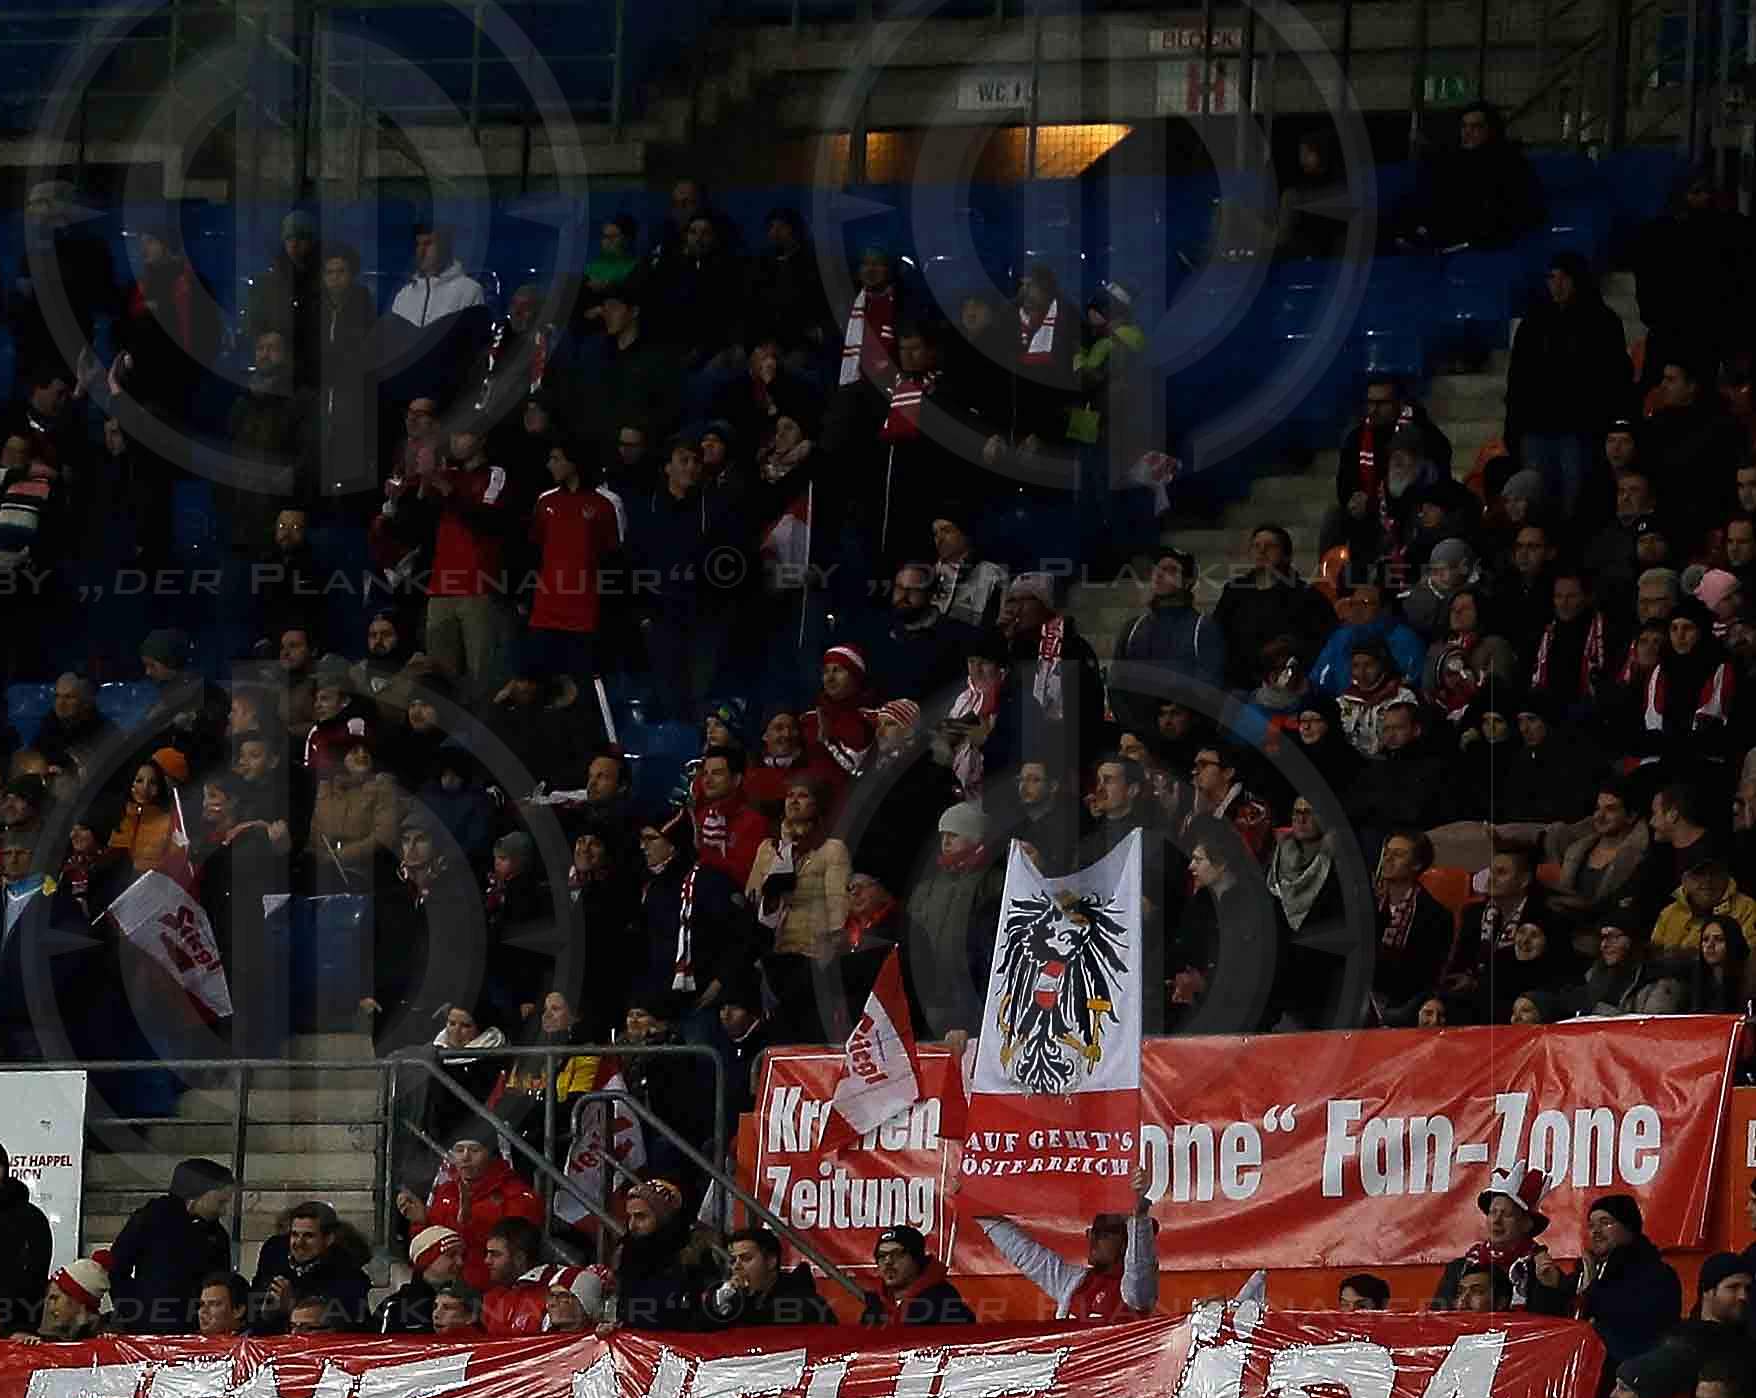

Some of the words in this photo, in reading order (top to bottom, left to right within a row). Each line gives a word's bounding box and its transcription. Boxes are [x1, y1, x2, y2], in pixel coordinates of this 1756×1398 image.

[767, 1087, 941, 1153] Kren
[965, 1131, 1020, 1152] AUF
[30, 1155, 73, 1168] HAPPEL
[961, 1153, 1130, 1176] ÖSTERREICH
[765, 1162, 936, 1235] Zeitung
